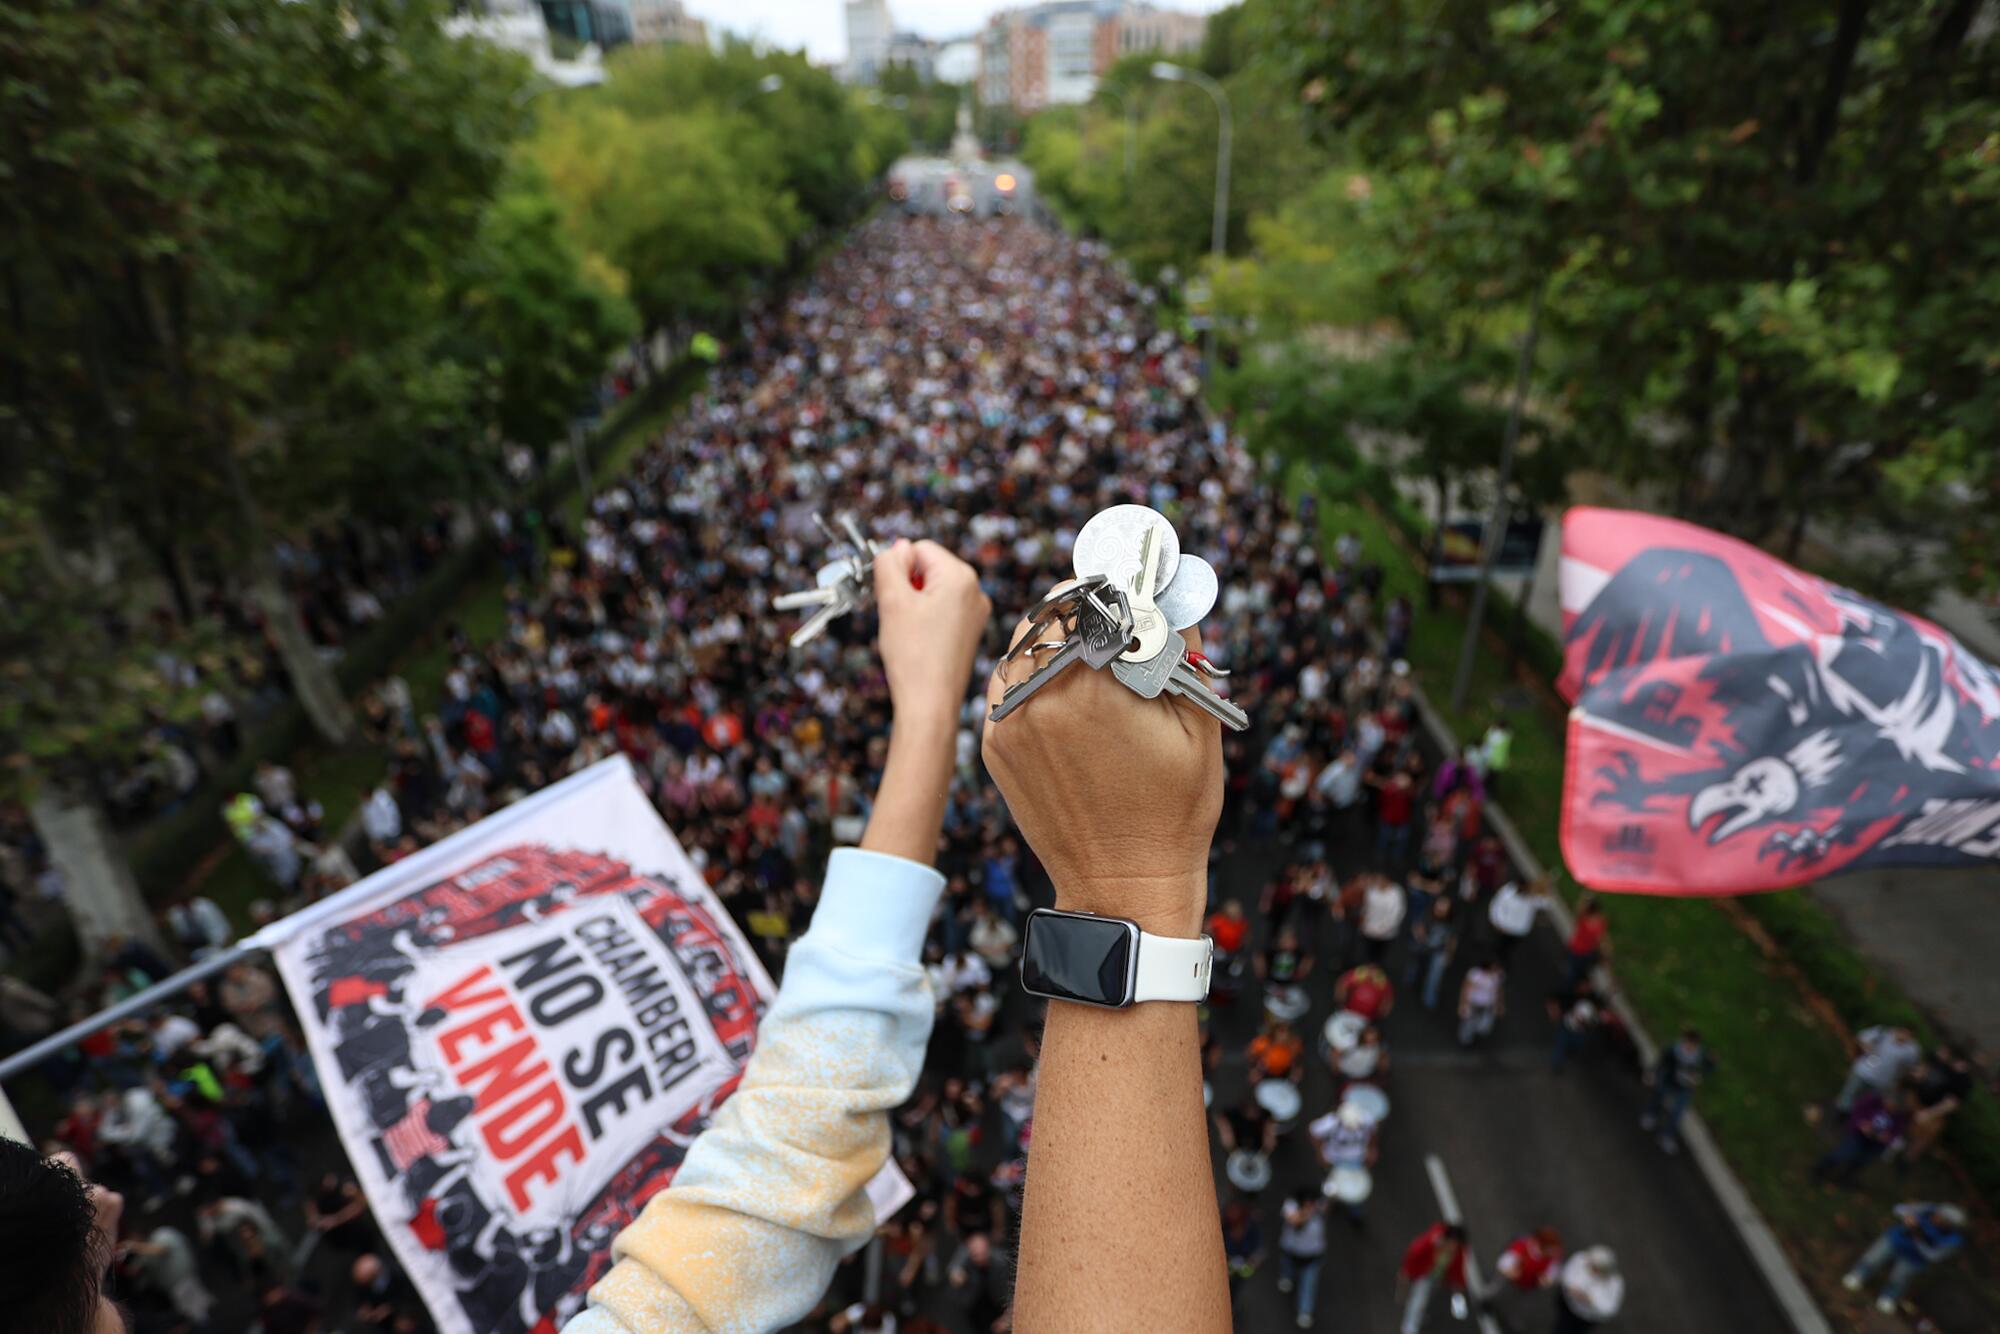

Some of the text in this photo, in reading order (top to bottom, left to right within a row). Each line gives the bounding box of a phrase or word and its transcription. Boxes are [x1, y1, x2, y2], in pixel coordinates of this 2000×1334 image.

[424, 965, 586, 1214] VENDE
[499, 936, 653, 1140] NO SE
